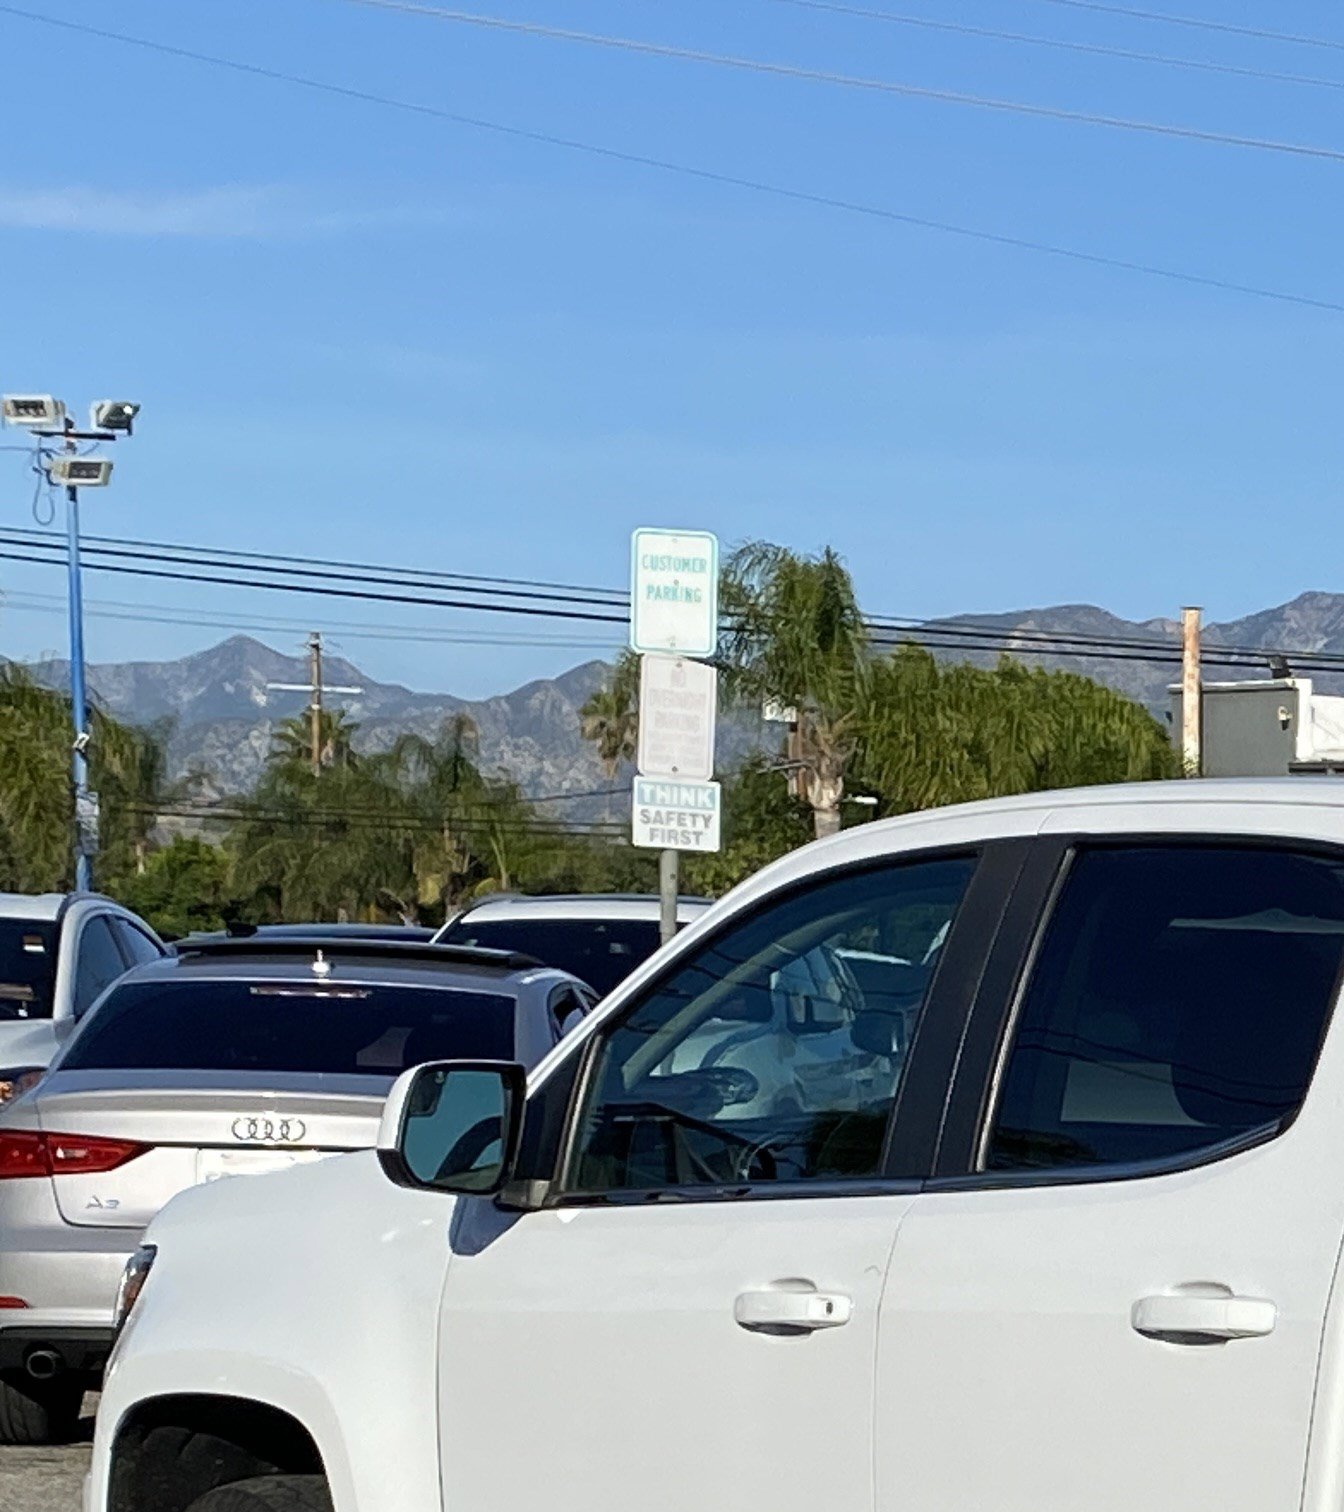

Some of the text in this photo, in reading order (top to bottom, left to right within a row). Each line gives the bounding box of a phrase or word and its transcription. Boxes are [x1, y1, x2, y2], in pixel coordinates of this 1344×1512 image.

[642, 554, 707, 573] CUSTOMER
[646, 584, 702, 603] PARKING
[639, 783, 715, 809] THINK
[639, 809, 715, 829] SAFETY
[649, 826, 704, 846] FIRST
